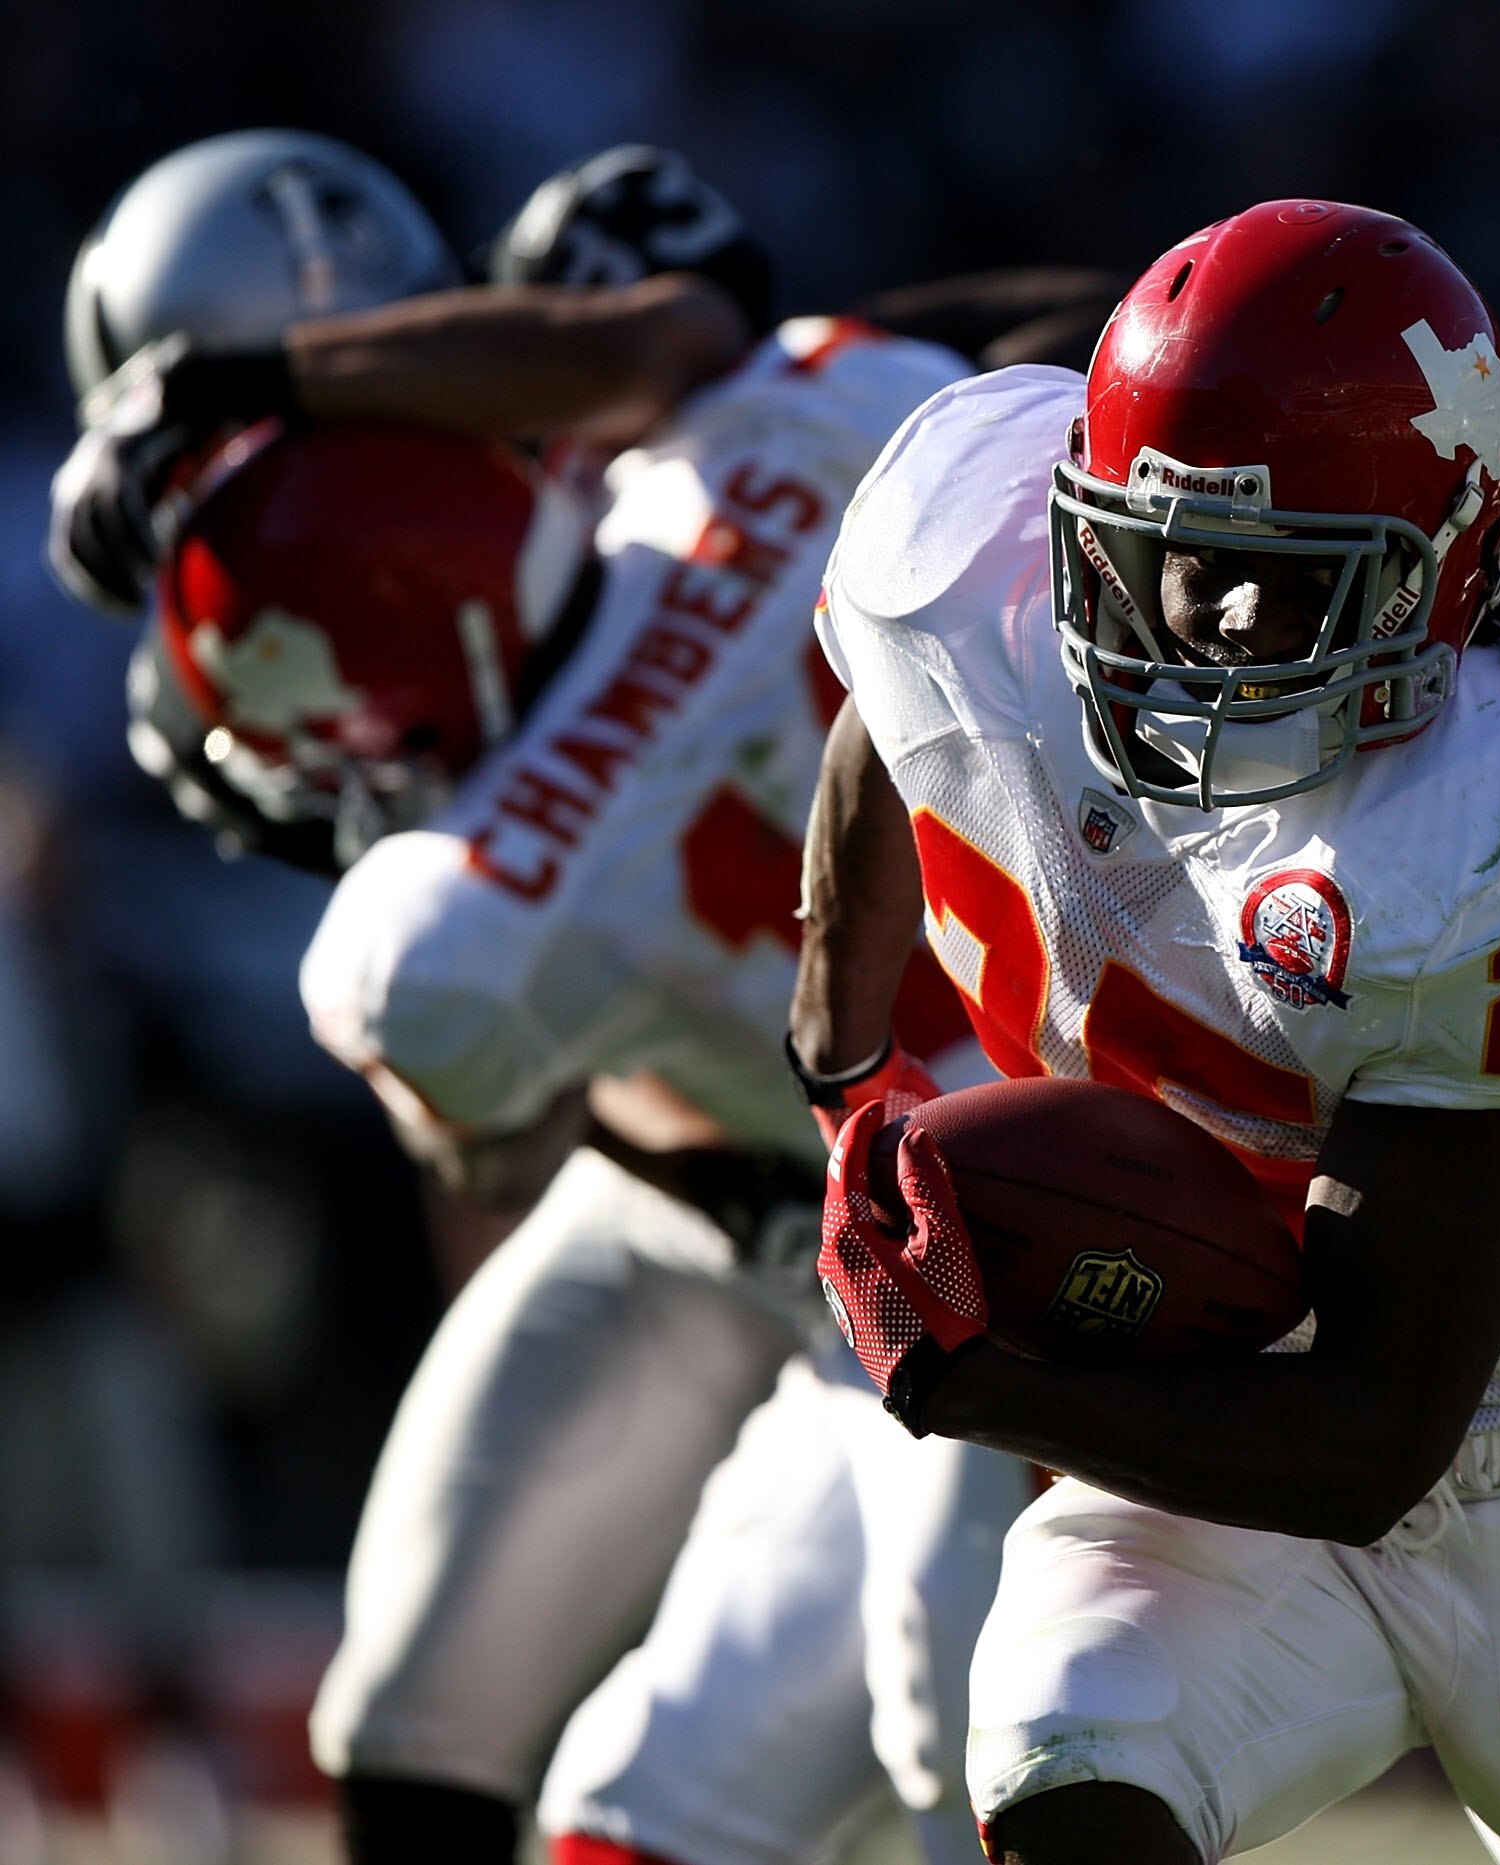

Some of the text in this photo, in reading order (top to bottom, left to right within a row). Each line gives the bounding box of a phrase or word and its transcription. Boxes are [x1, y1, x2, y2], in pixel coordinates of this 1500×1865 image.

[1162, 467, 1236, 497] Riddell
[1079, 527, 1136, 618] Riddell
[1372, 585, 1419, 640] ddell
[468, 459, 821, 901] CHAMBERS
[1079, 1261, 1152, 1319] NFL
